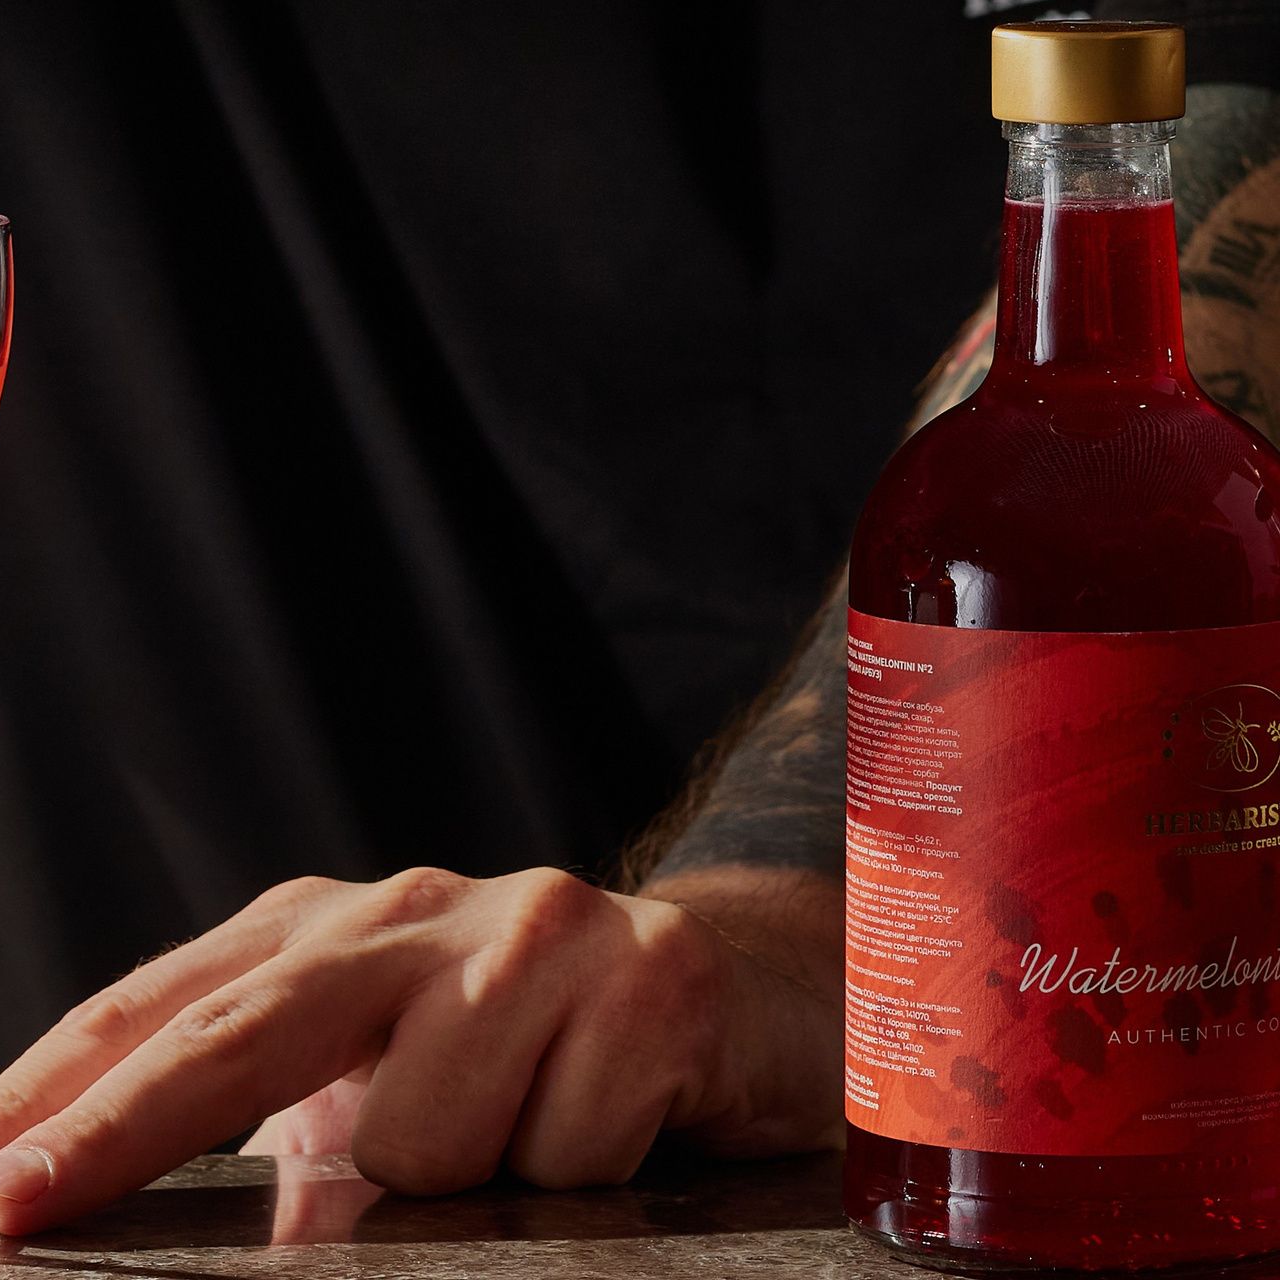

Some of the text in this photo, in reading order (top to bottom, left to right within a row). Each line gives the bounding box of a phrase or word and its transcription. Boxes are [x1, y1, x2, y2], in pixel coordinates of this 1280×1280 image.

[858, 652, 915, 672] WATERMELONTINI
[903, 701, 916, 709] сок
[916, 703, 944, 714] арбуза,
[911, 714, 934, 724] сахар,
[904, 724, 935, 734] экстракт
[937, 728, 960, 737] мяты,
[926, 738, 959, 749] кислота,
[902, 746, 932, 756] кислота,
[934, 750, 962, 759] цитрат
[905, 756, 944, 769] сукралоза,
[913, 768, 940, 779] сорбат
[926, 781, 962, 792] Продукт
[892, 788, 922, 800] арахиса,
[924, 792, 956, 804] орехов,
[898, 798, 936, 810] Содержит
[938, 805, 962, 816] сахар
[1144, 802, 1280, 837] HERBARIS
[915, 835, 934, 845] 54,62
[903, 844, 916, 853] 100
[922, 847, 960, 859] продукта.
[1199, 839, 1239, 855] desire
[1241, 840, 1253, 851] to
[891, 864, 902, 873] 100
[908, 867, 944, 879] продукта.
[884, 885, 940, 900] вентилируемом
[916, 902, 941, 913] лучей,
[943, 906, 959, 914] при
[897, 910, 906, 918] не
[907, 912, 928, 922] выше
[894, 922, 916, 930] сырья
[906, 934, 923, 944] цвет
[924, 937, 962, 948] продукта
[915, 946, 951, 958] годности
[893, 954, 919, 964] партии.
[910, 1000, 915, 1008] и
[1107, 1022, 1246, 1044] AUTHENTIC
[905, 1066, 918, 1075] стр.
